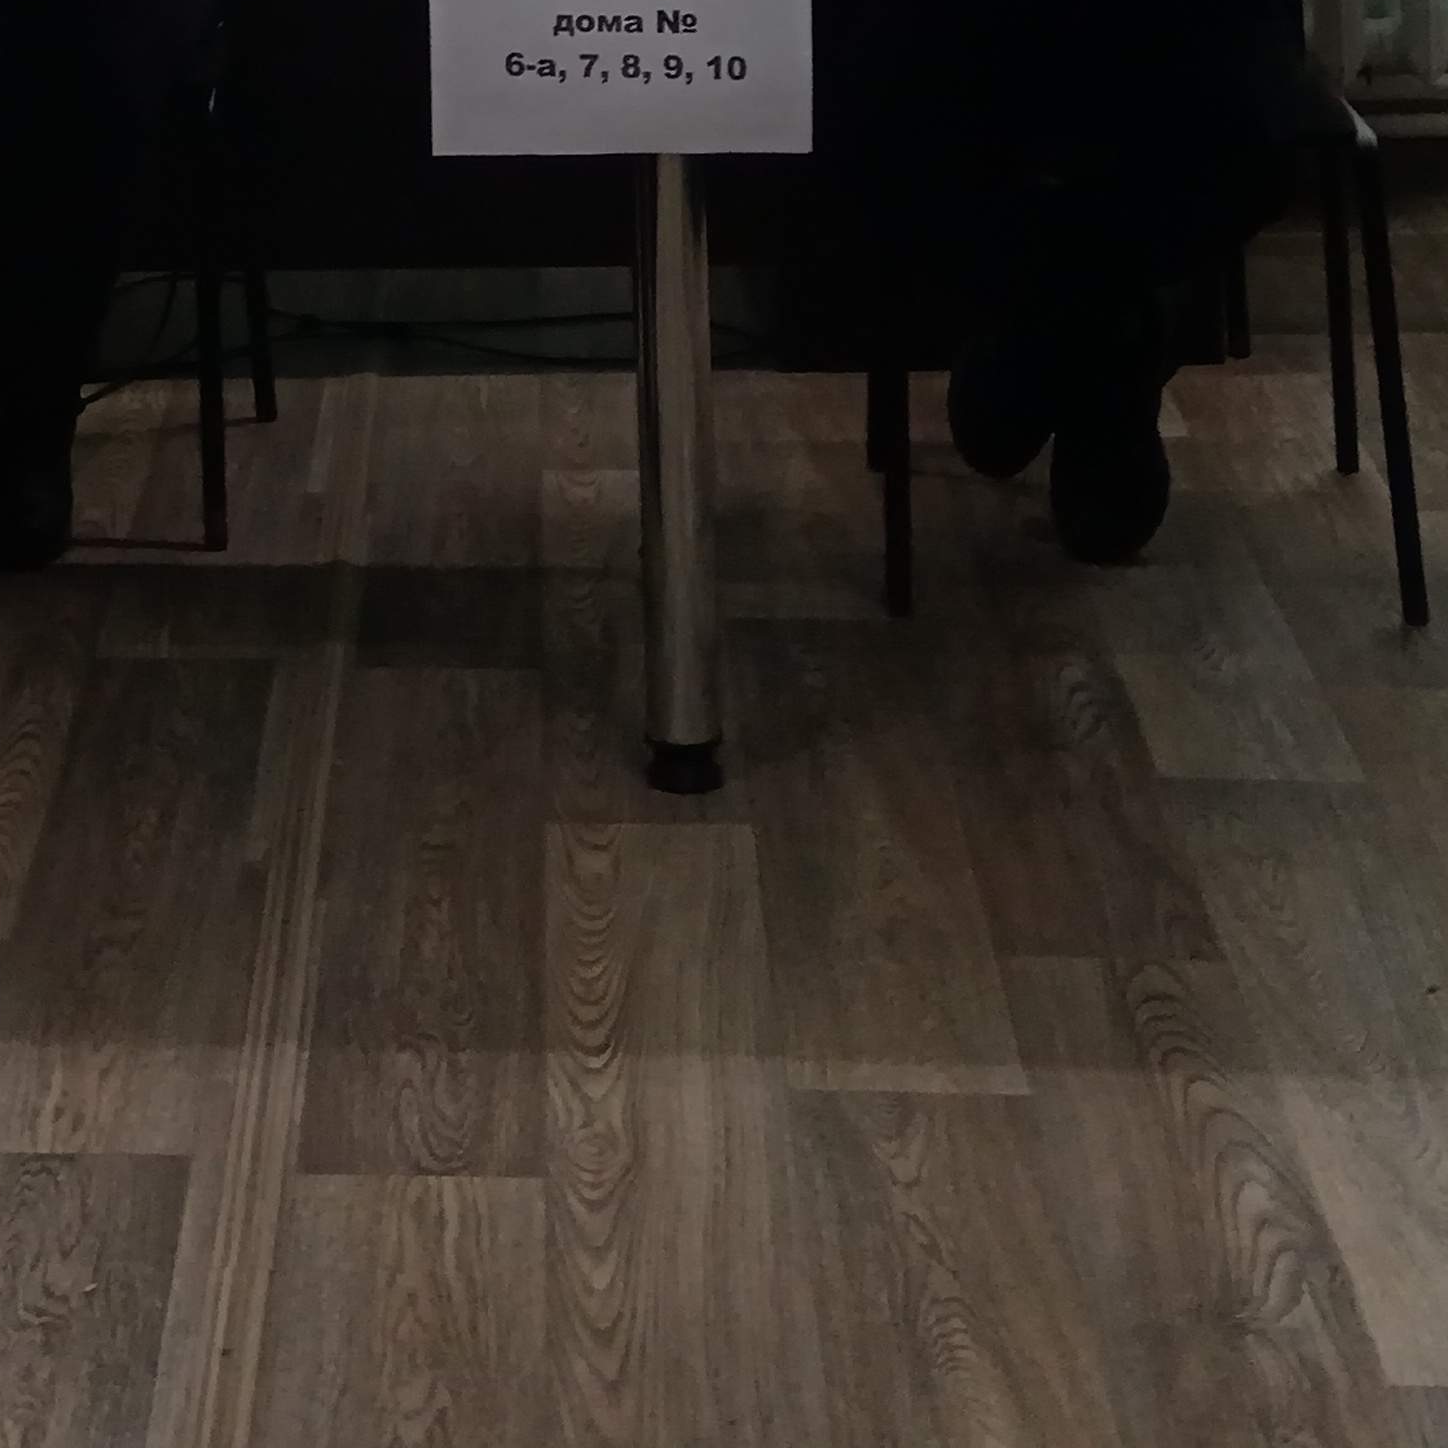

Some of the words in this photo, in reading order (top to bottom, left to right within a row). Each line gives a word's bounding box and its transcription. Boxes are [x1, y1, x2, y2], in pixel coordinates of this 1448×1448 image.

[553, 11, 644, 37] дома
[656, 9, 699, 35] №
[504, 51, 568, 84] 6-а,
[579, 53, 610, 85] 7,
[620, 53, 652, 85] 8,
[662, 54, 694, 85] 9,
[706, 55, 748, 81] 10
